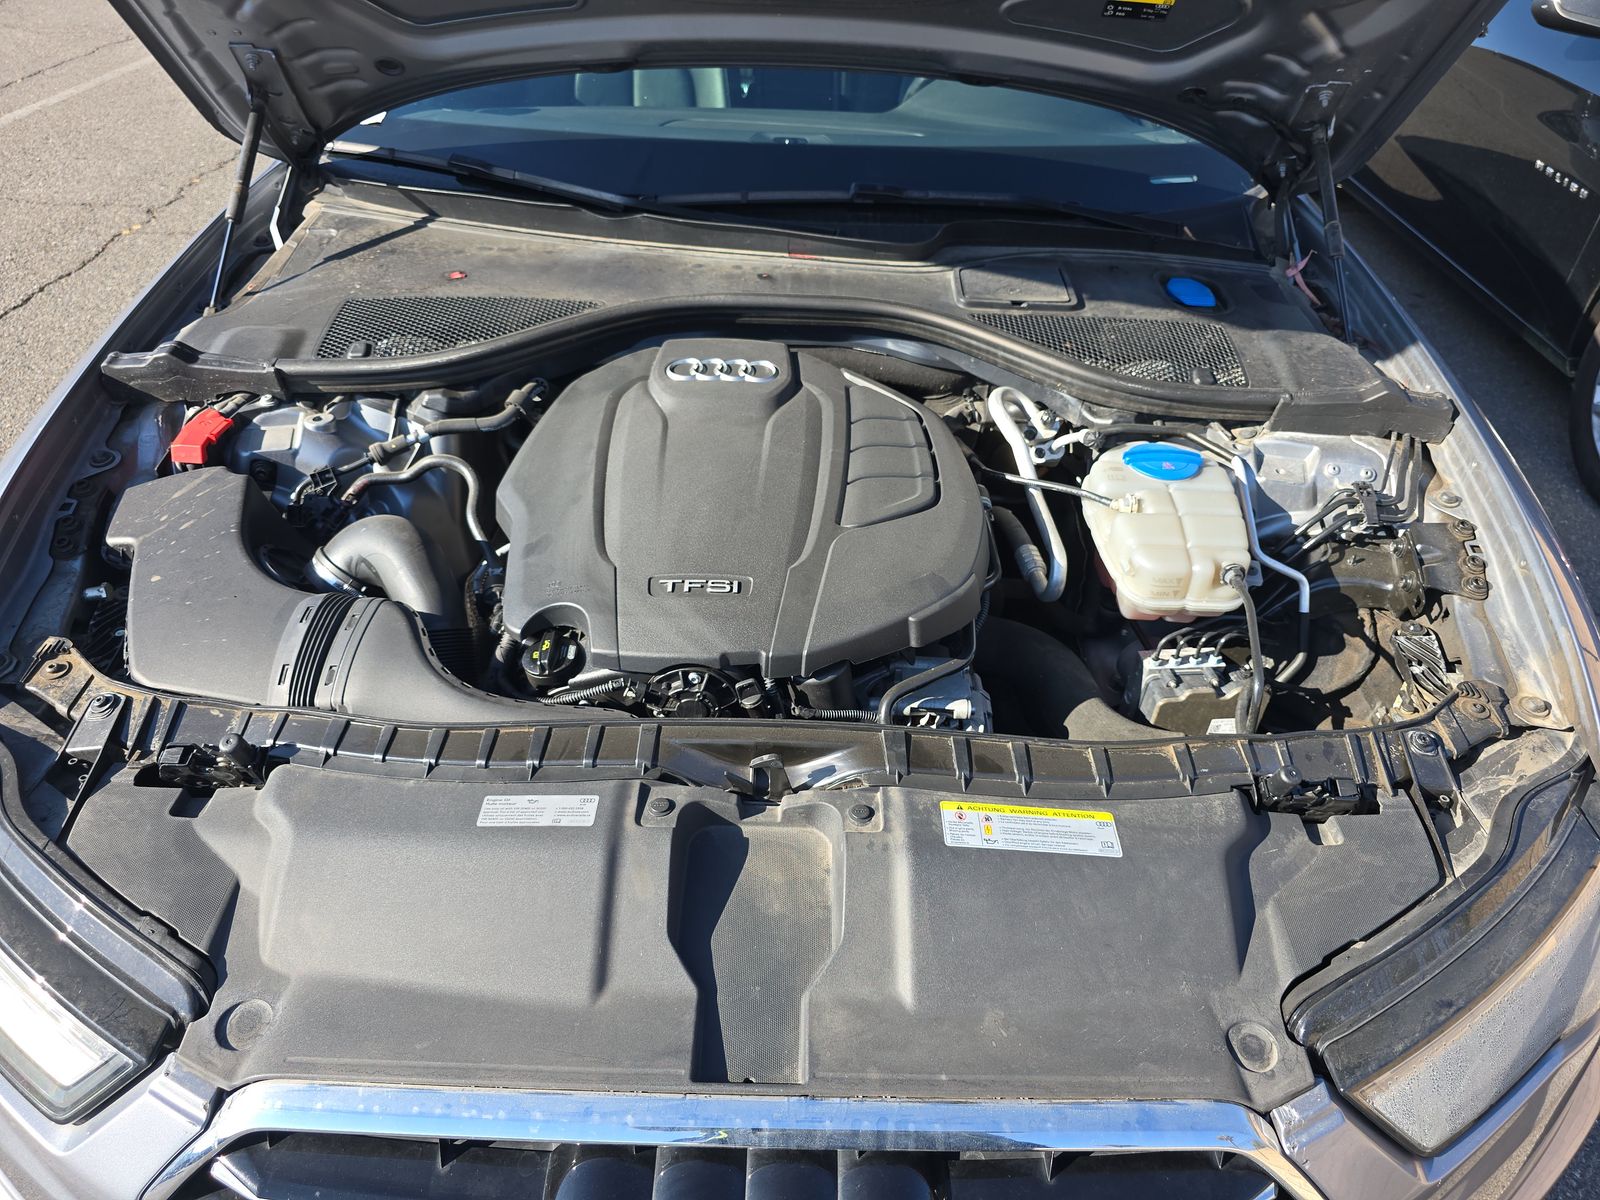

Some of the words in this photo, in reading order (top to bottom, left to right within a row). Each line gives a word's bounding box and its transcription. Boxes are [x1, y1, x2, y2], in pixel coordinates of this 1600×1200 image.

[659, 579, 741, 594] TFSI
[967, 805, 1006, 813] ACHTUNG
[1009, 808, 1048, 816] WARNING
[1052, 811, 1096, 819] ATTENTION
